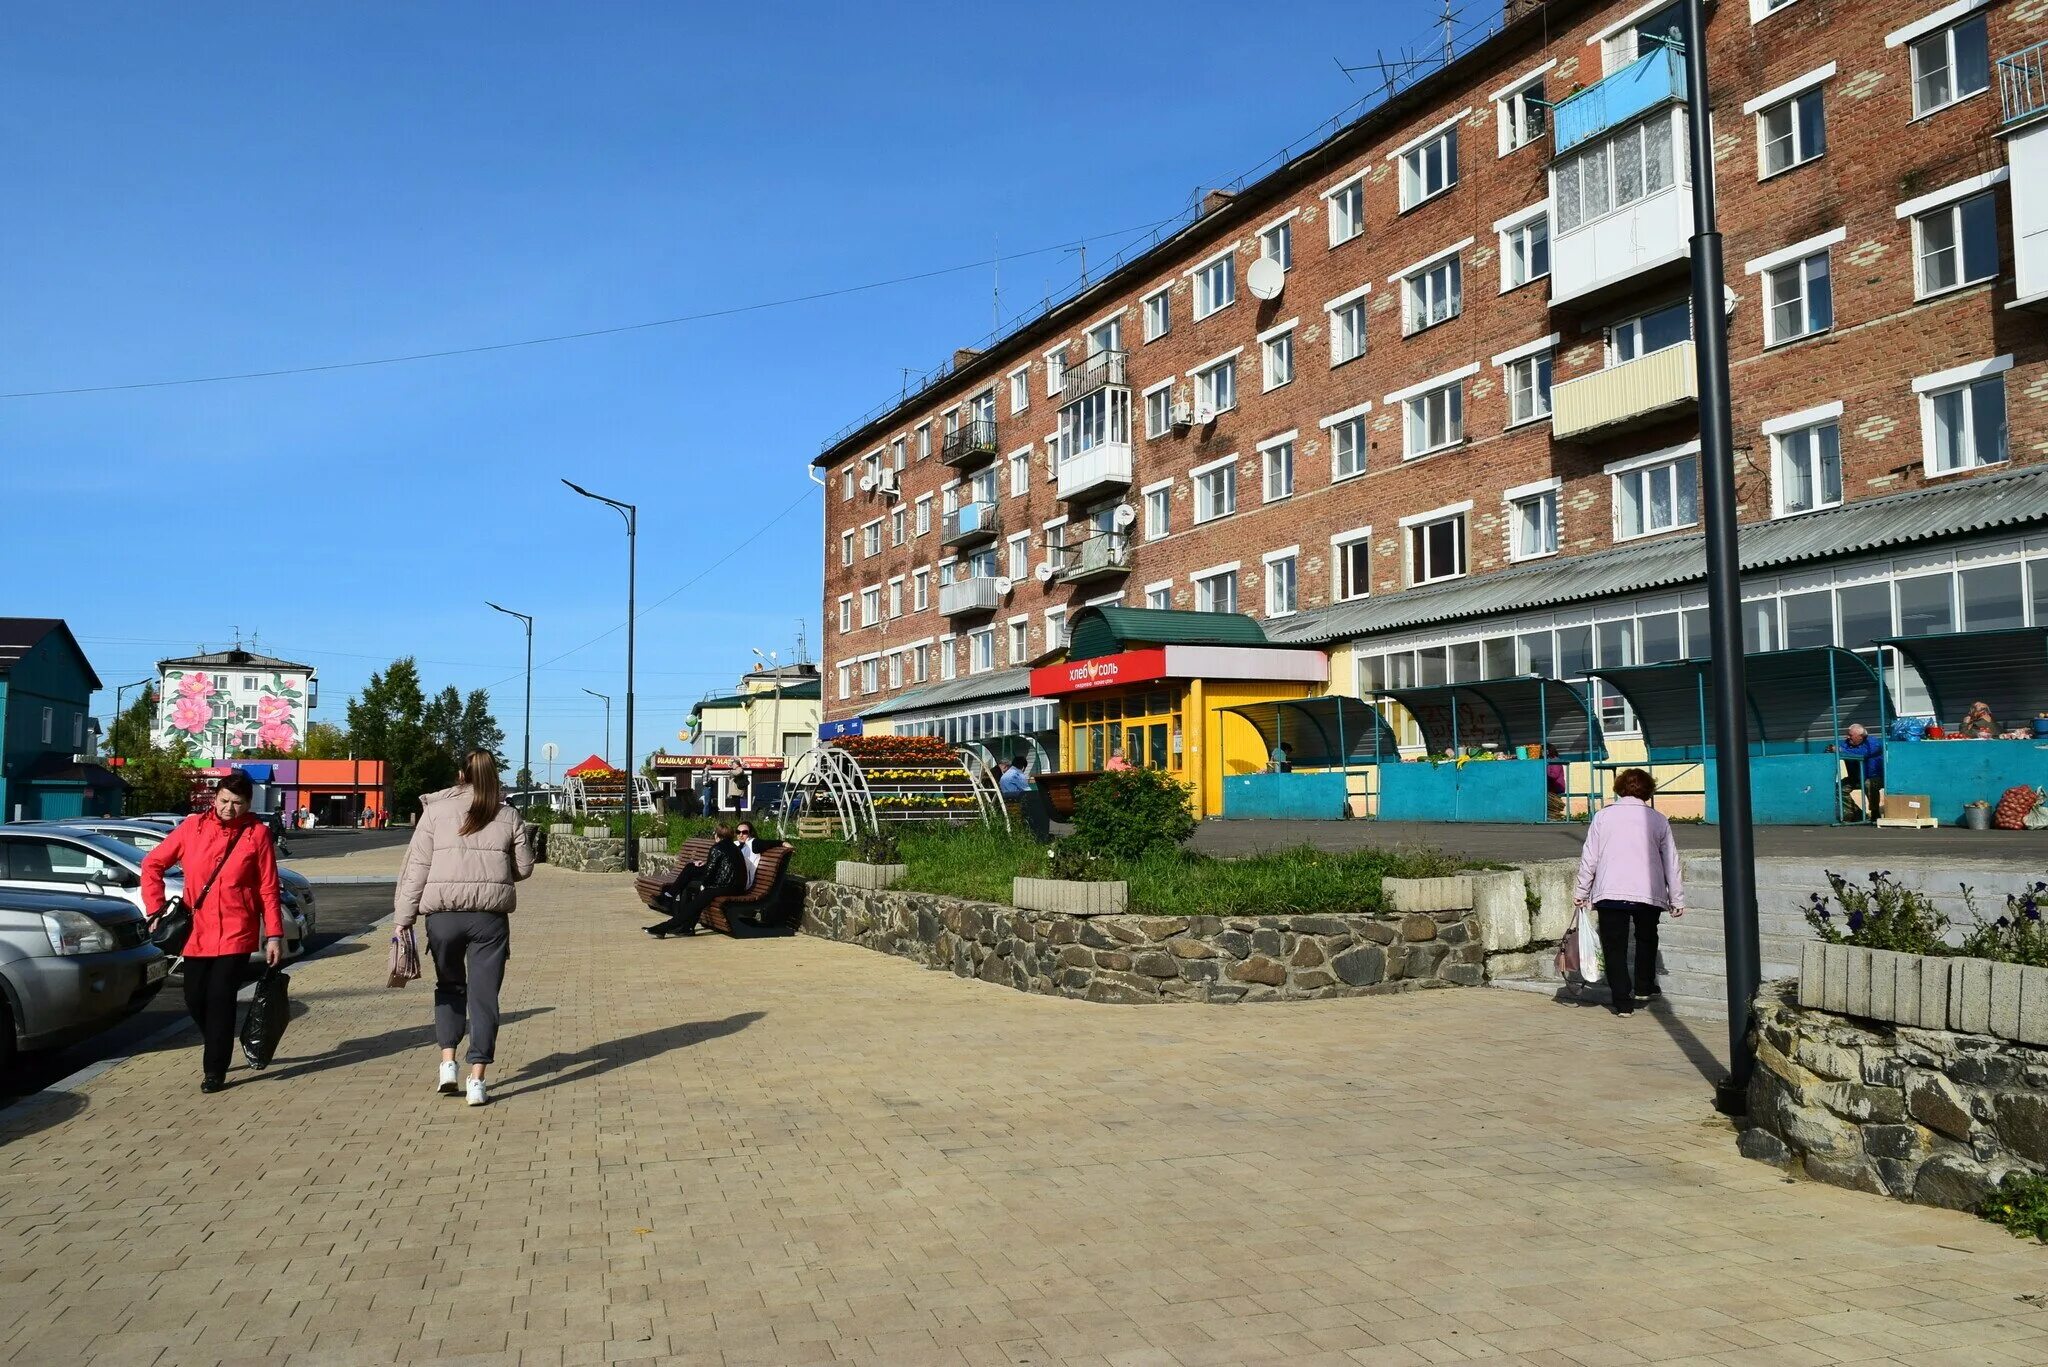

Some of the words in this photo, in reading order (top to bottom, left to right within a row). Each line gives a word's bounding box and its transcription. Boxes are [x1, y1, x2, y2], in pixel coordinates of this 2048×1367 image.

[1098, 663, 1118, 676] соль
[657, 757, 692, 765] ШАШЛЫК
[695, 757, 729, 765] ШАРМА
